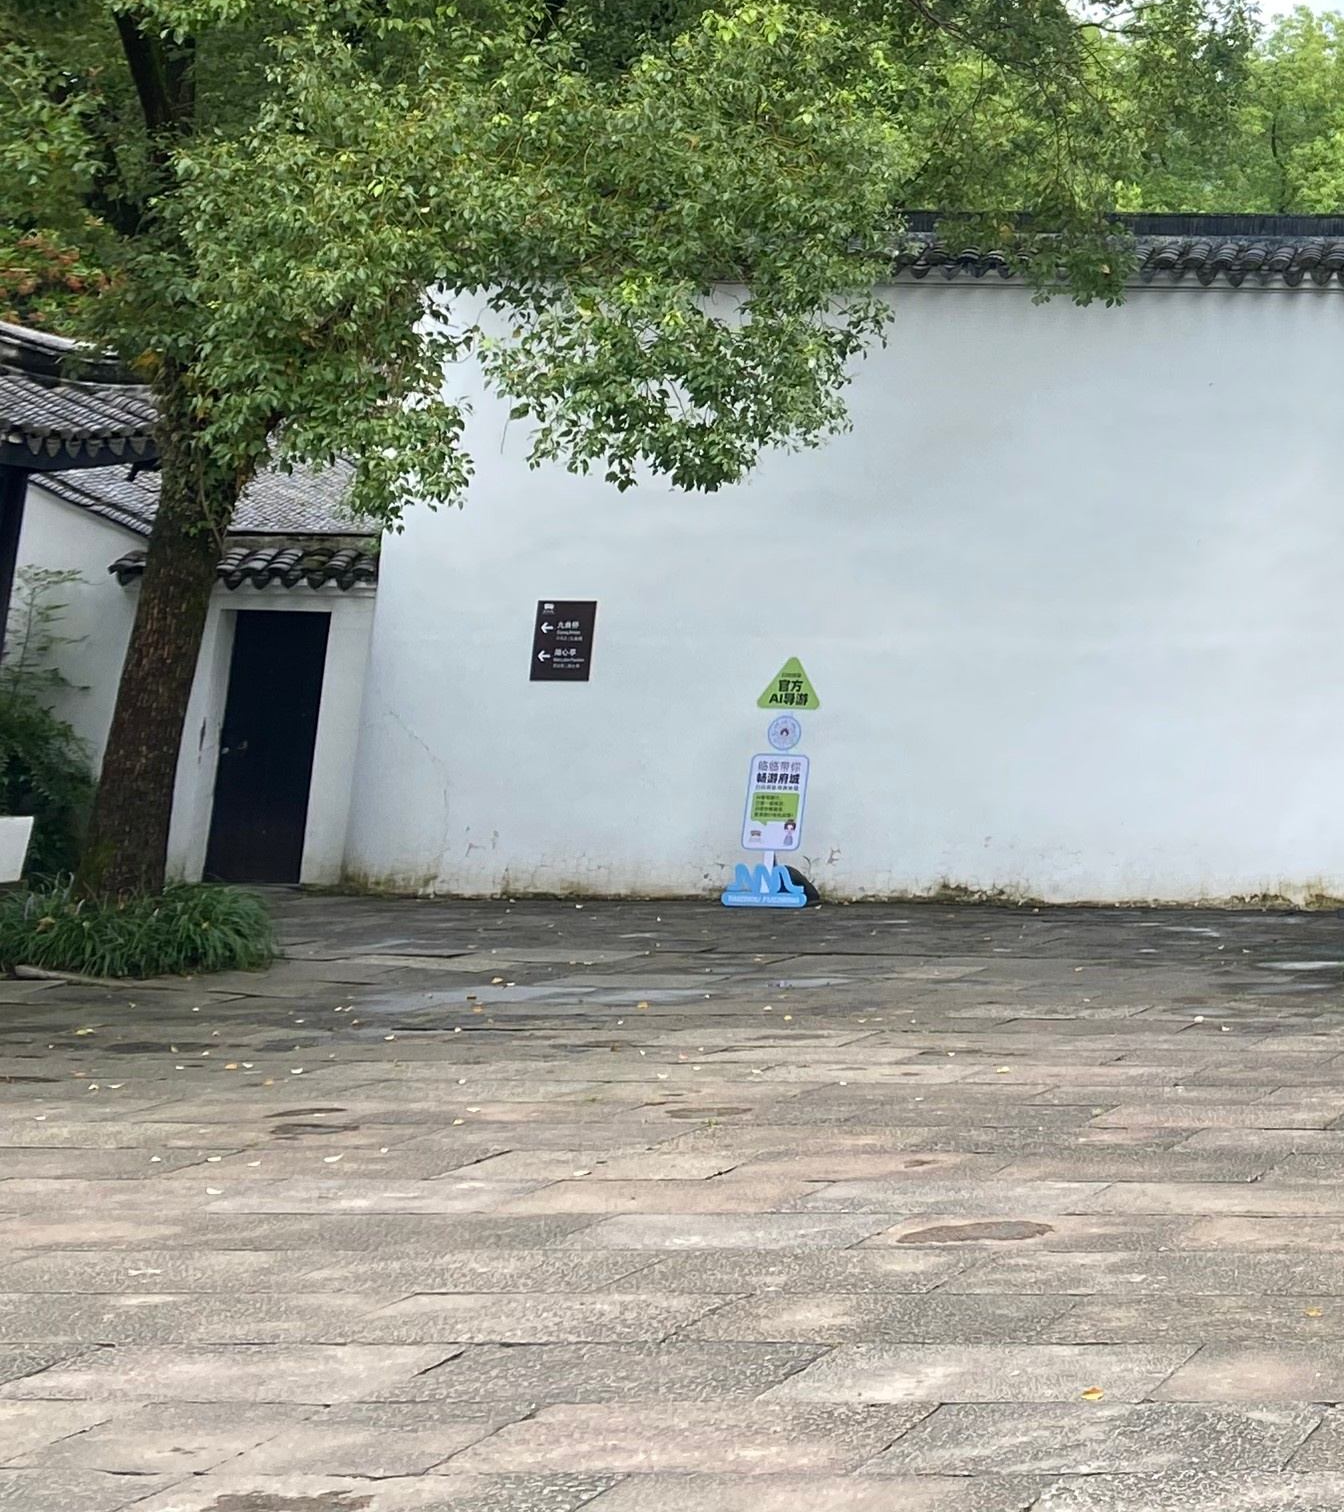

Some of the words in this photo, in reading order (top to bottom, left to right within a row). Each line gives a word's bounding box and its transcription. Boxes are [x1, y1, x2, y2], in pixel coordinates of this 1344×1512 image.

[778, 679, 804, 692] 官方
[768, 692, 809, 706] AI导游
[756, 771, 800, 784] 畅游府城
